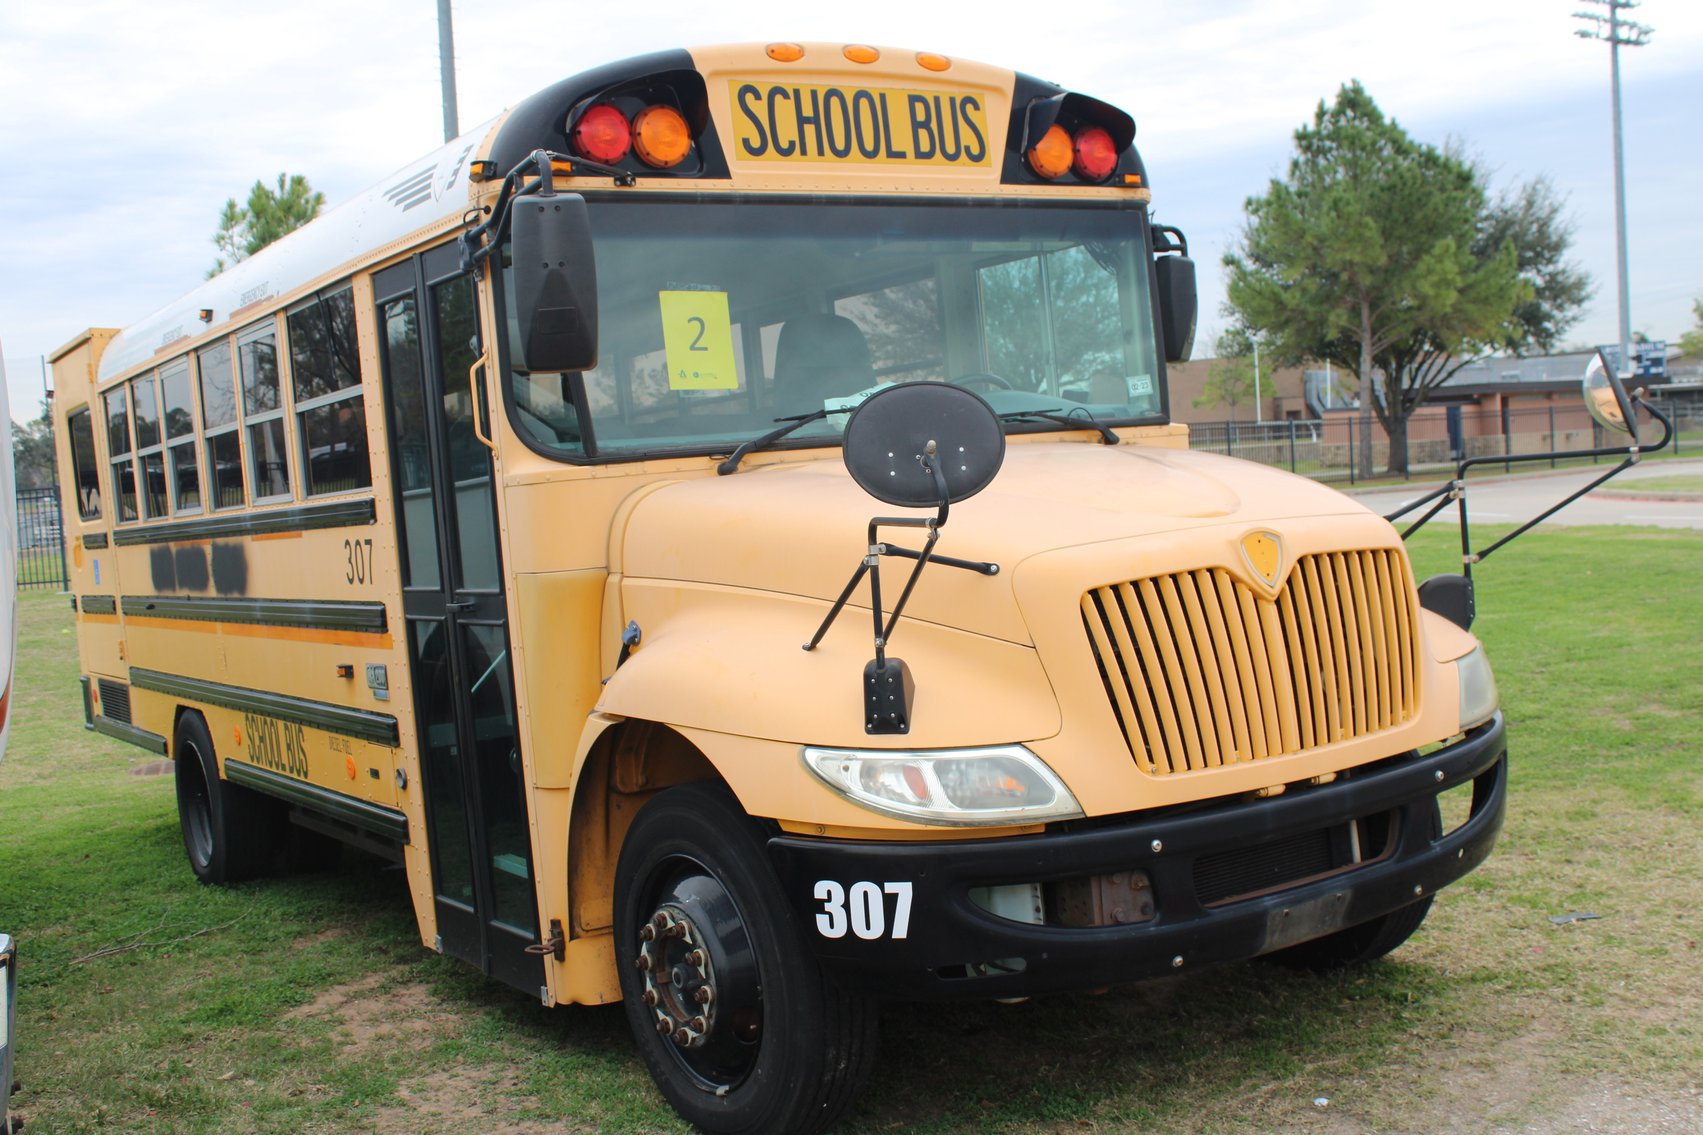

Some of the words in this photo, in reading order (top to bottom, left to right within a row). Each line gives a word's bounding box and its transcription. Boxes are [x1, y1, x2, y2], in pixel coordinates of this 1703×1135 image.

[737, 83, 907, 160] SCHOOL
[907, 93, 987, 163] BUS
[687, 316, 708, 352] 2
[344, 538, 373, 585] 307
[245, 711, 287, 772] SCHOOL
[283, 722, 309, 780] BUS
[813, 880, 913, 940] 307
